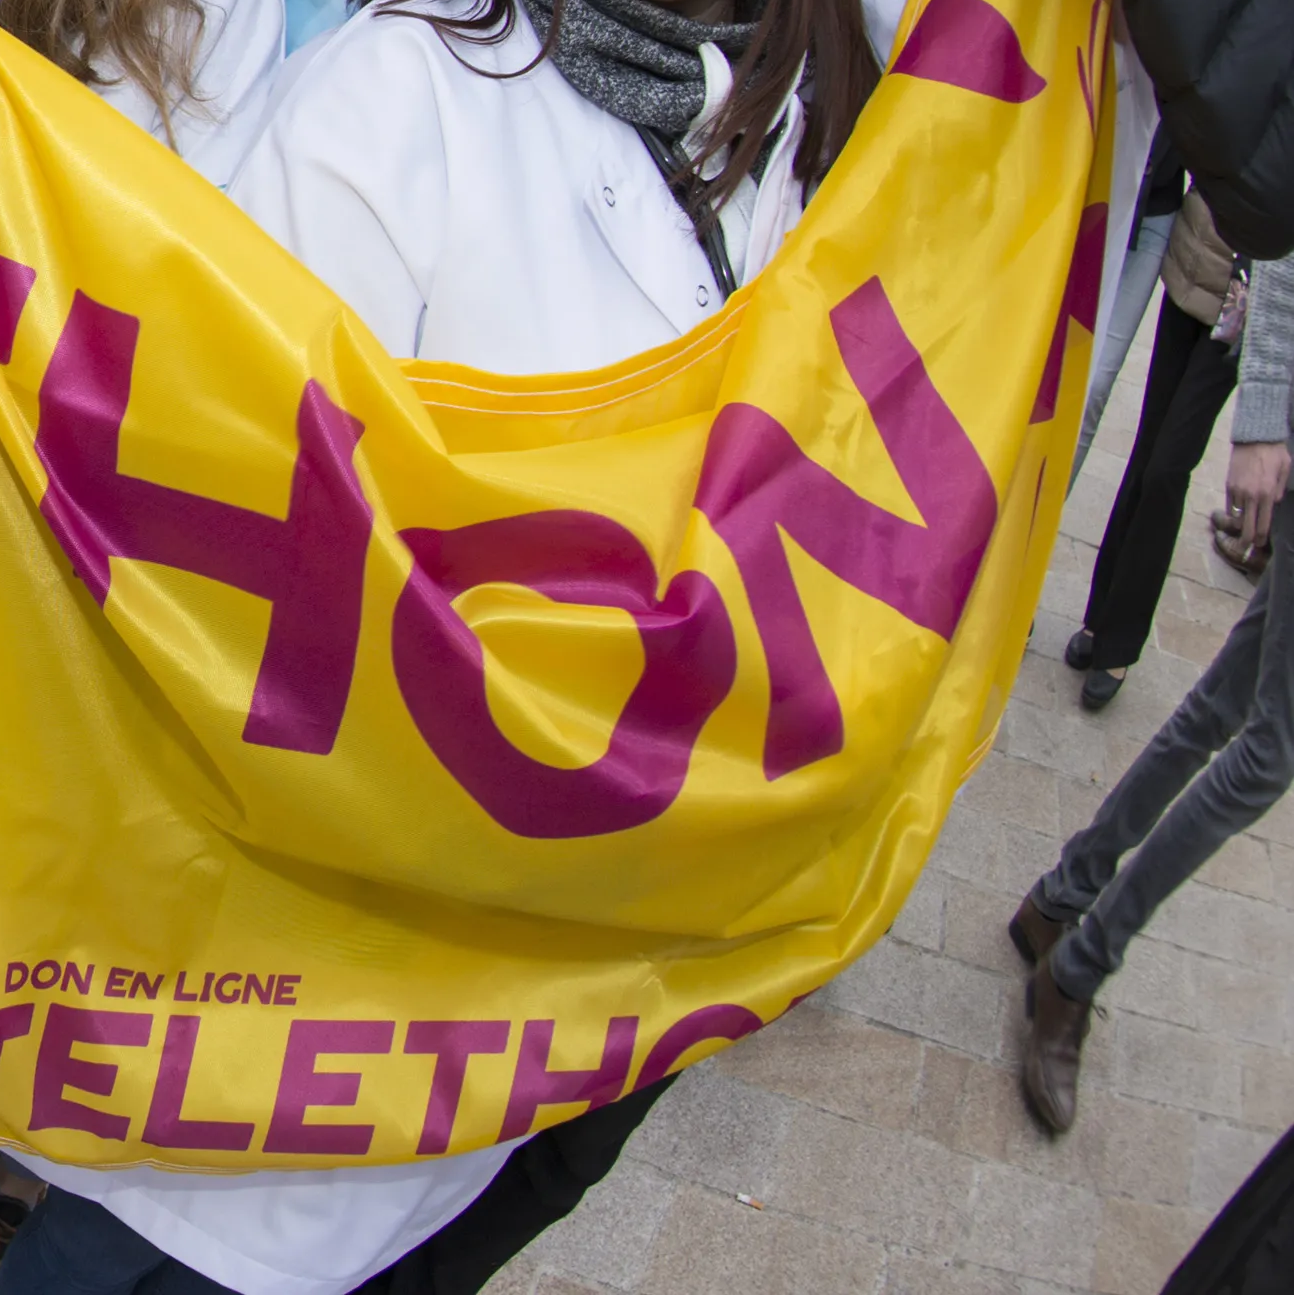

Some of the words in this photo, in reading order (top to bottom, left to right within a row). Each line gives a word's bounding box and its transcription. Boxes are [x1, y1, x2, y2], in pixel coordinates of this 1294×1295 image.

[4, 959, 92, 996] DON
[104, 967, 165, 1002] EN
[174, 970, 302, 1007] LIGNE
